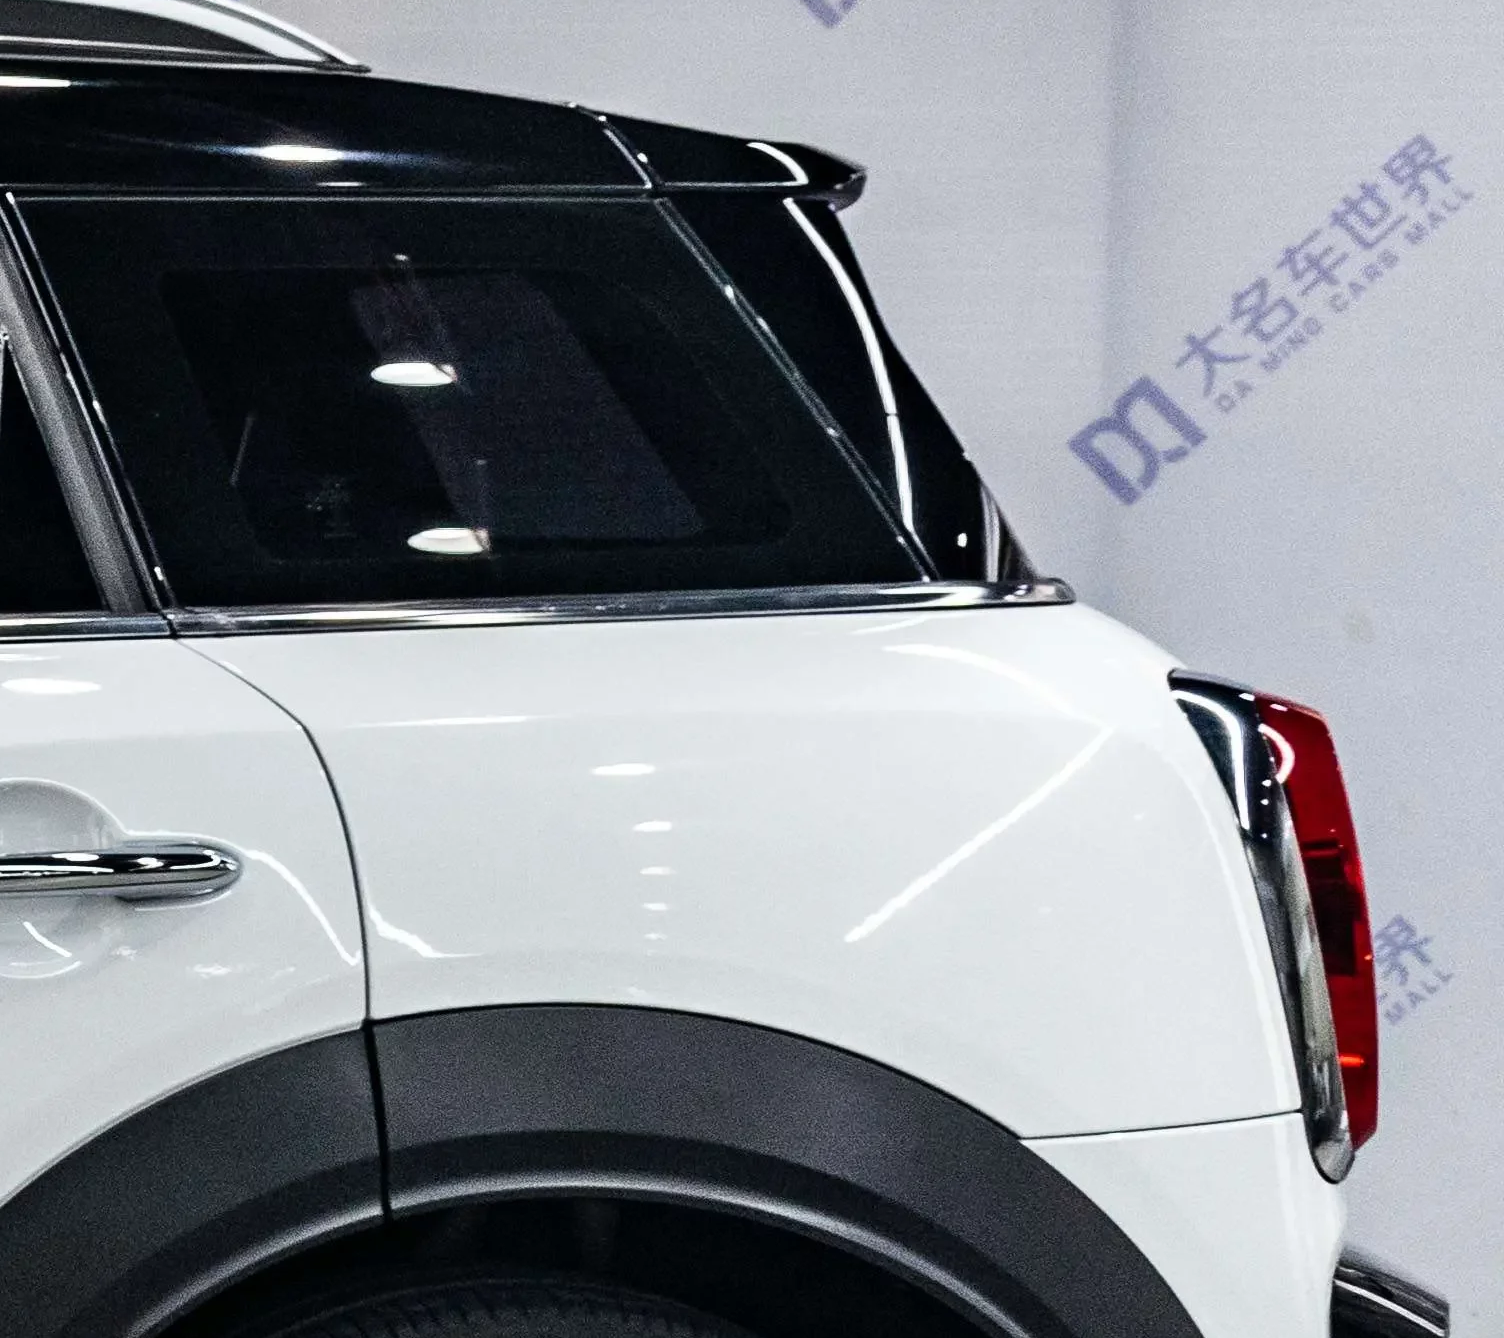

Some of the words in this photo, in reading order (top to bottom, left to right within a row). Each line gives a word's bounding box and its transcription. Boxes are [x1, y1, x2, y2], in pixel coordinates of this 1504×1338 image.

[1179, 136, 1453, 395] 大名车世界
